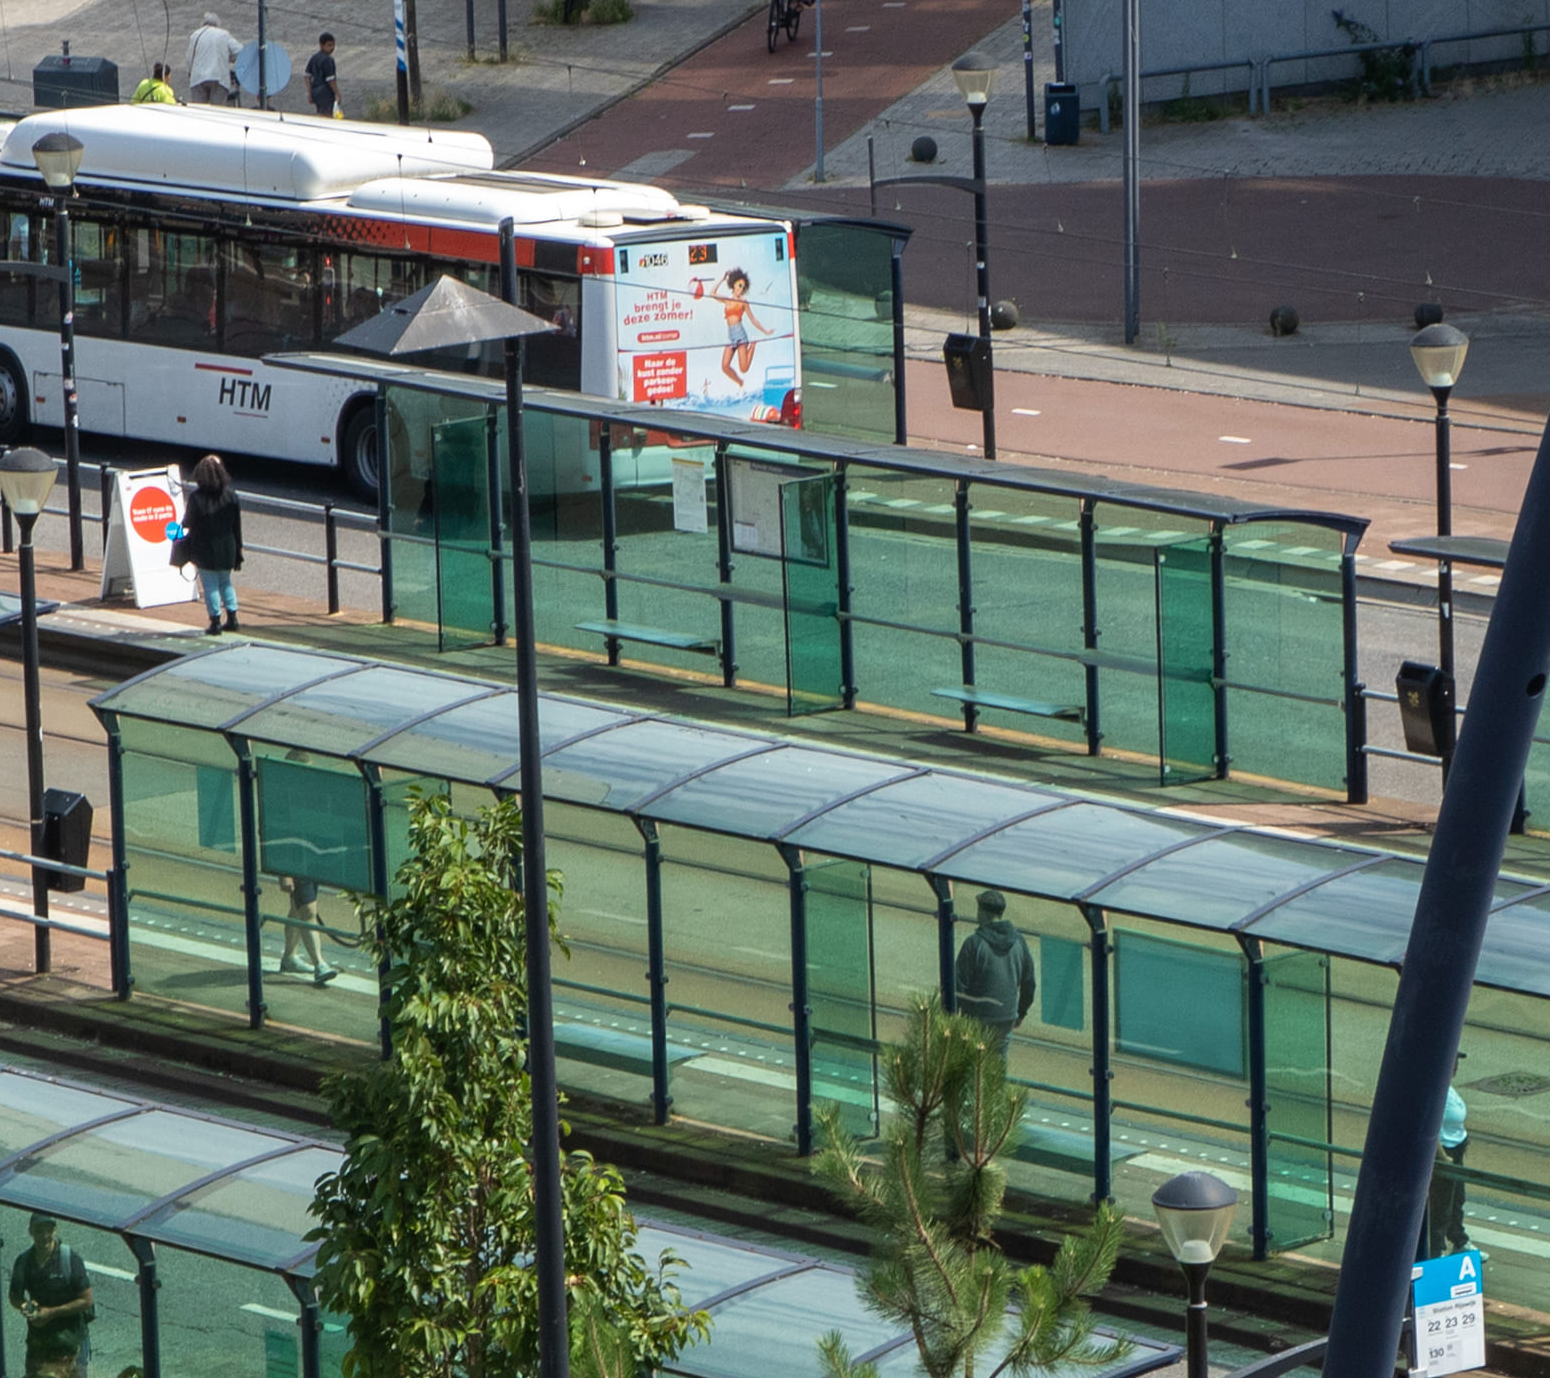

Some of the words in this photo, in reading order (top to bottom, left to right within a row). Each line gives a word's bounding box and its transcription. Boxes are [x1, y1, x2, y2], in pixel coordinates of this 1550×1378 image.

[646, 291, 668, 302] HTM
[634, 301, 668, 314] brengt
[670, 301, 682, 312] je
[623, 314, 650, 326] deze
[654, 309, 694, 321] zomer!
[218, 377, 272, 412] HTM
[1459, 1256, 1476, 1281] A
[1428, 1322, 1442, 1333] 22
[1445, 1317, 1458, 1329] 23
[1462, 1313, 1476, 1326] 29
[1429, 1348, 1445, 1359] 130
